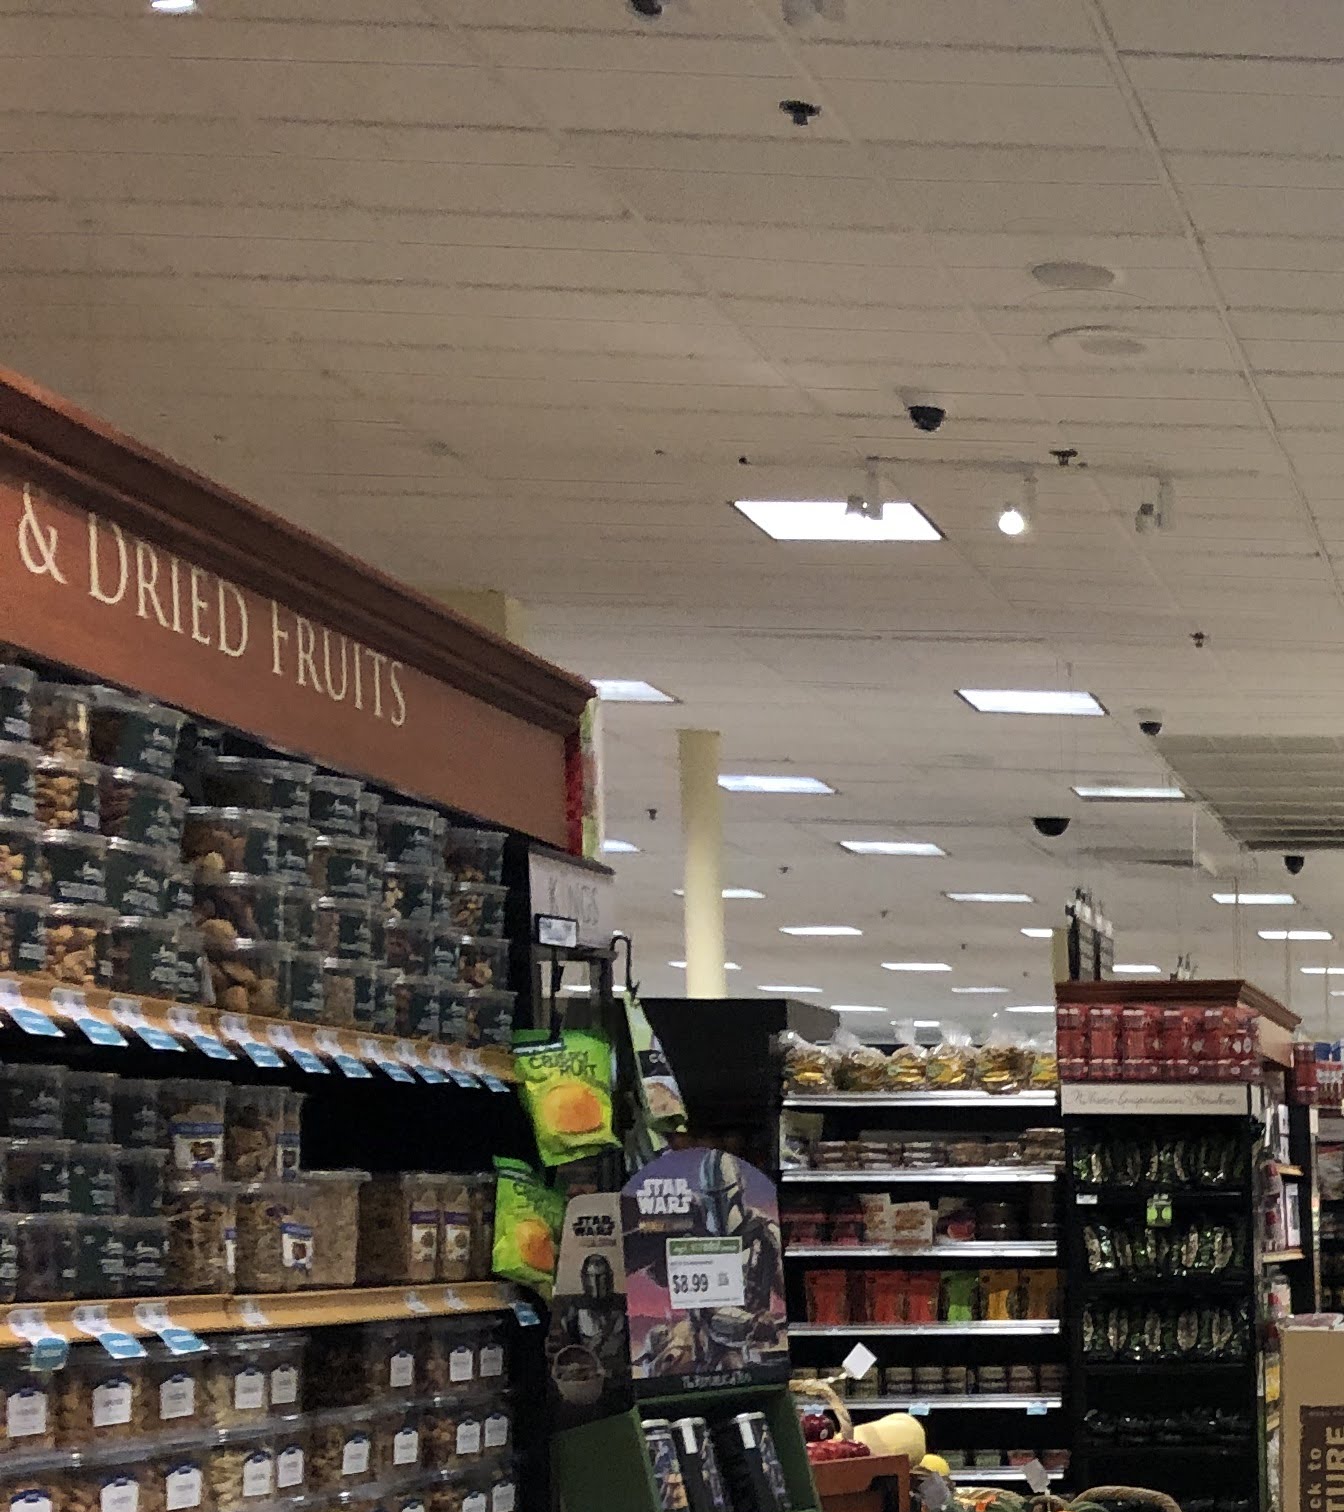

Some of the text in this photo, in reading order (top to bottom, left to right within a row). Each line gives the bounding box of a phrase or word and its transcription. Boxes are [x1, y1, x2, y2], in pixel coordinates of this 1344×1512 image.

[17, 482, 408, 728] & DRIED FRUITS
[636, 1178, 693, 1198] STAR
[636, 1196, 693, 1215] WARS
[572, 1215, 616, 1227] STAR
[573, 1224, 616, 1237] WARS
[672, 1273, 709, 1294] $8.99
[1308, 1448, 1322, 1472] to
